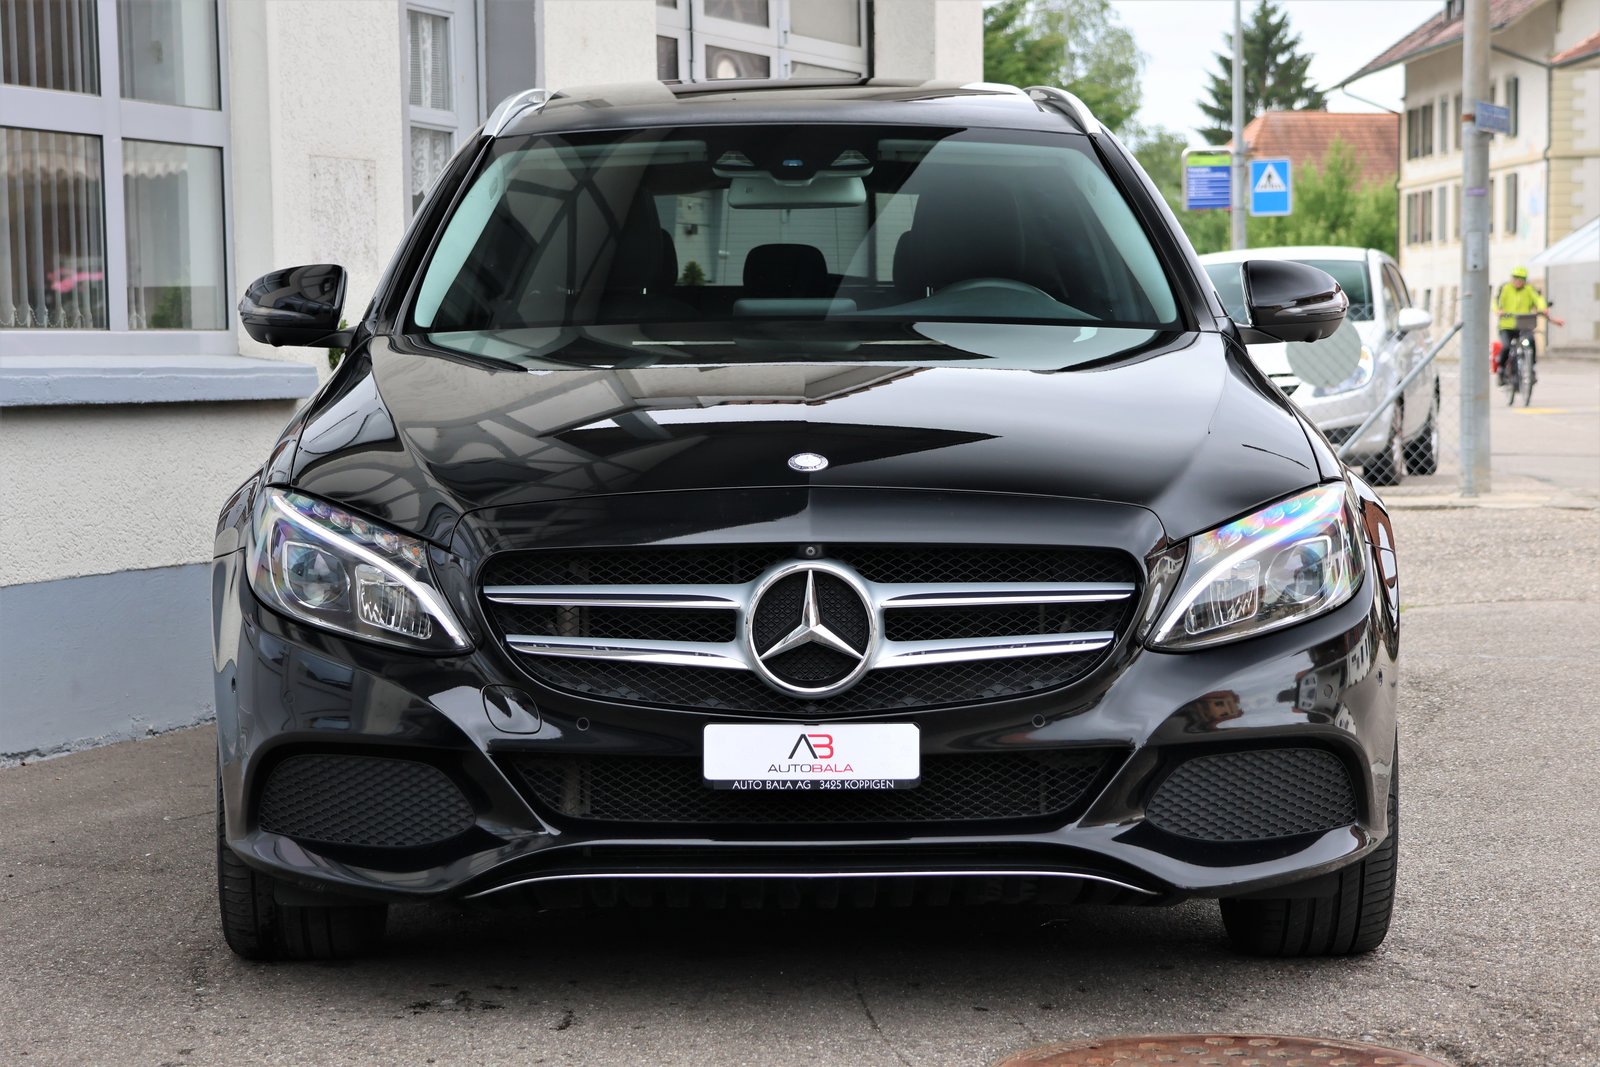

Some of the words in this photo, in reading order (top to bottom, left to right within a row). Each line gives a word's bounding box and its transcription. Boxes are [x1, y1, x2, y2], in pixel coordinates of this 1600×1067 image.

[788, 733, 834, 759] AB
[767, 763, 854, 773] AUTOBALA
[732, 780, 763, 790] AUTO
[765, 780, 793, 790] BALA
[795, 780, 811, 790] AG
[819, 780, 842, 790] 3425
[844, 780, 895, 790] KOPPIGEN
